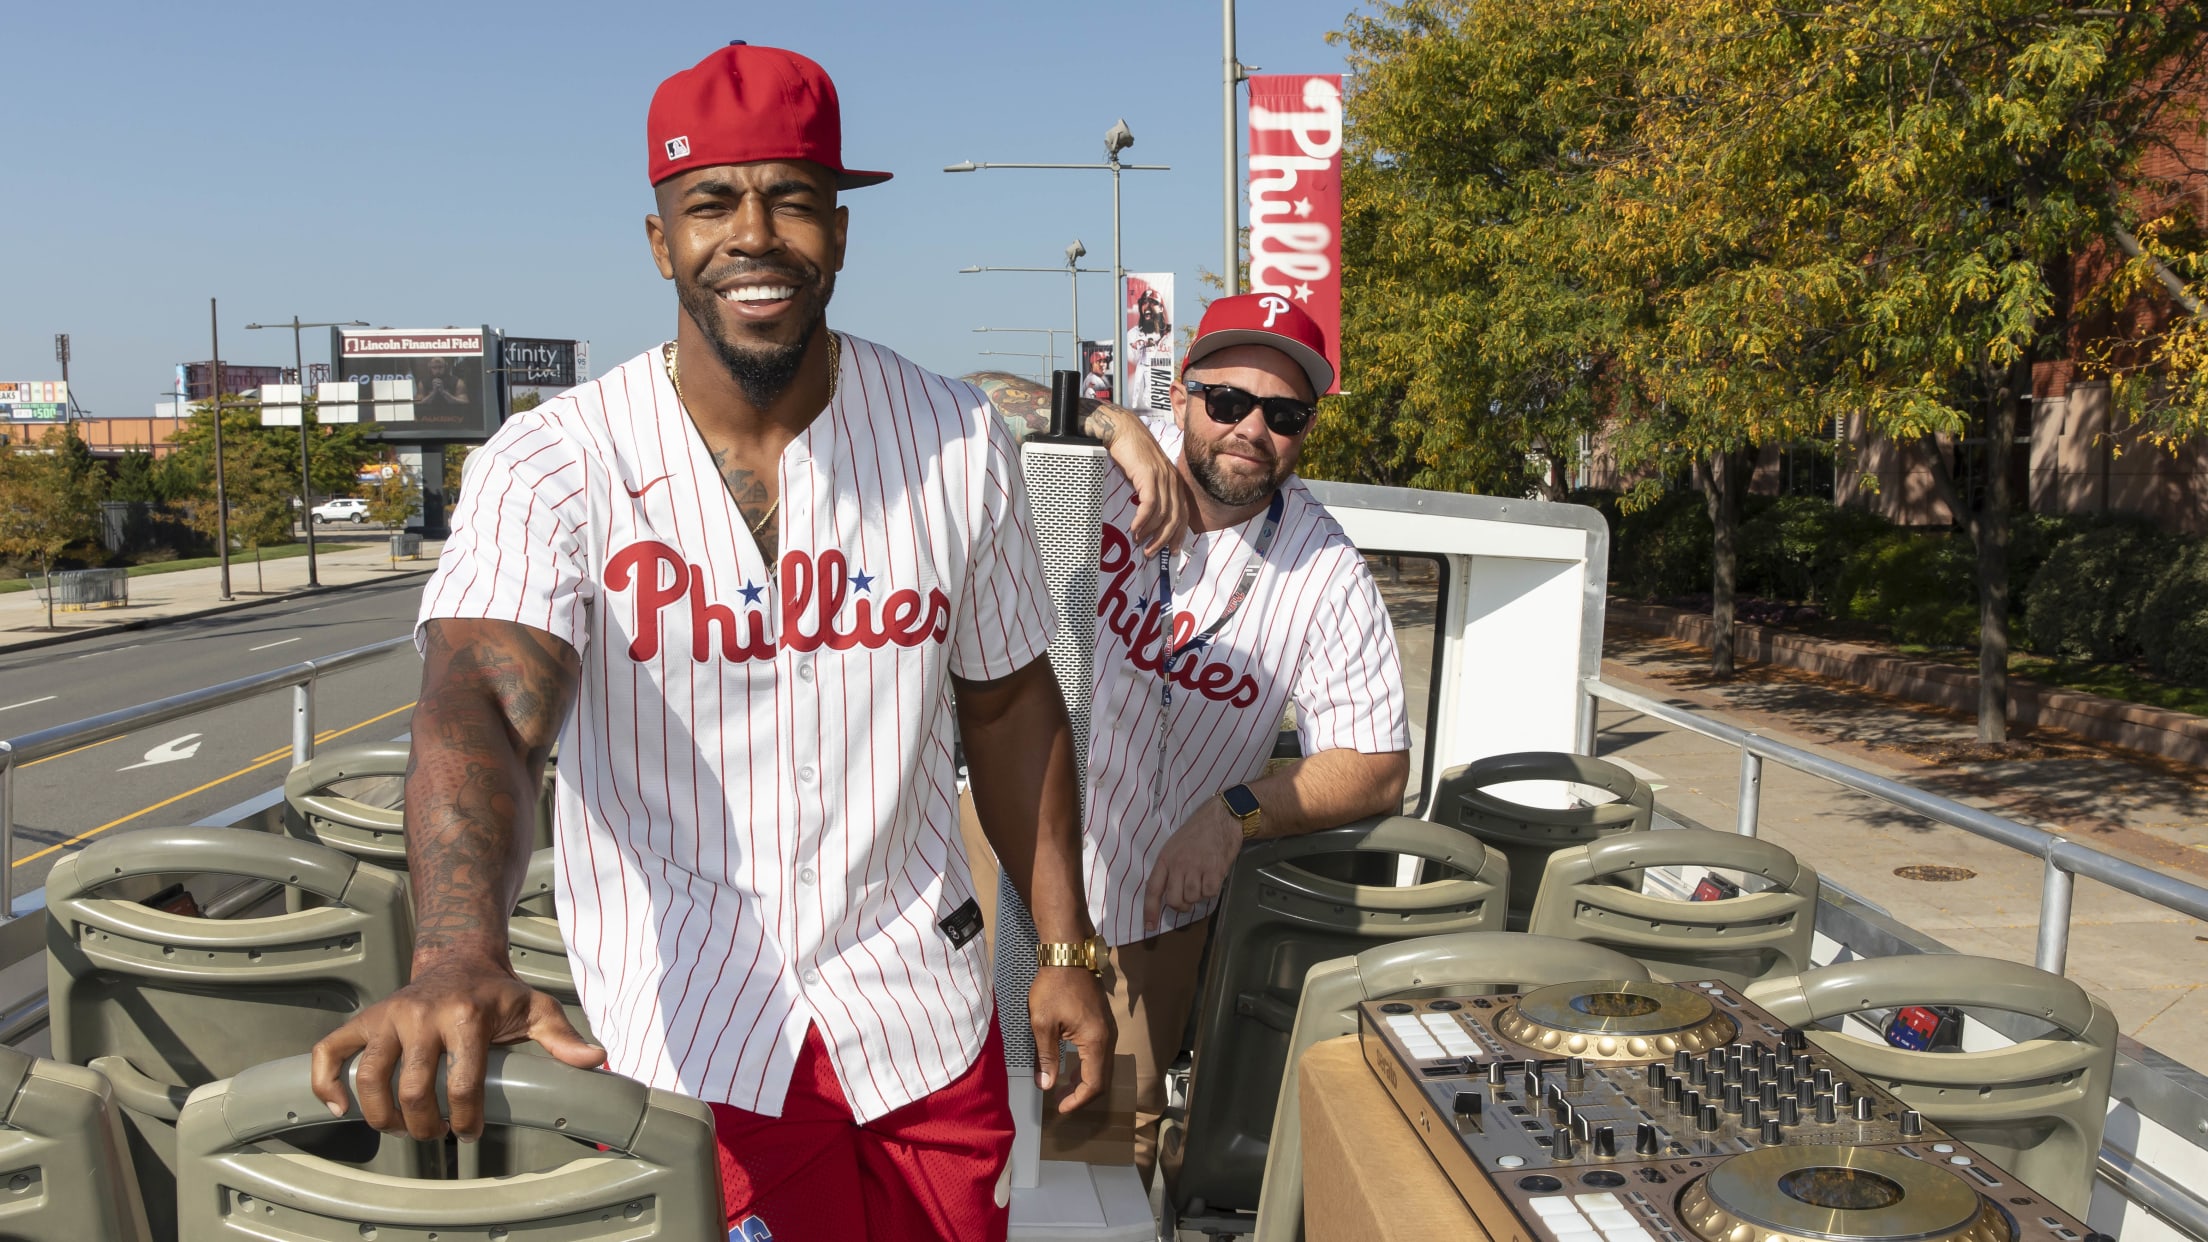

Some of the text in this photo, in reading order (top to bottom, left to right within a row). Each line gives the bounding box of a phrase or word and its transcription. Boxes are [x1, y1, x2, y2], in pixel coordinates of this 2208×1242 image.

[1258, 296, 1290, 328] P
[360, 338, 479, 350] Lincoln Financial Field
[1151, 367, 1171, 411] MARSH
[603, 540, 951, 663] Phillies
